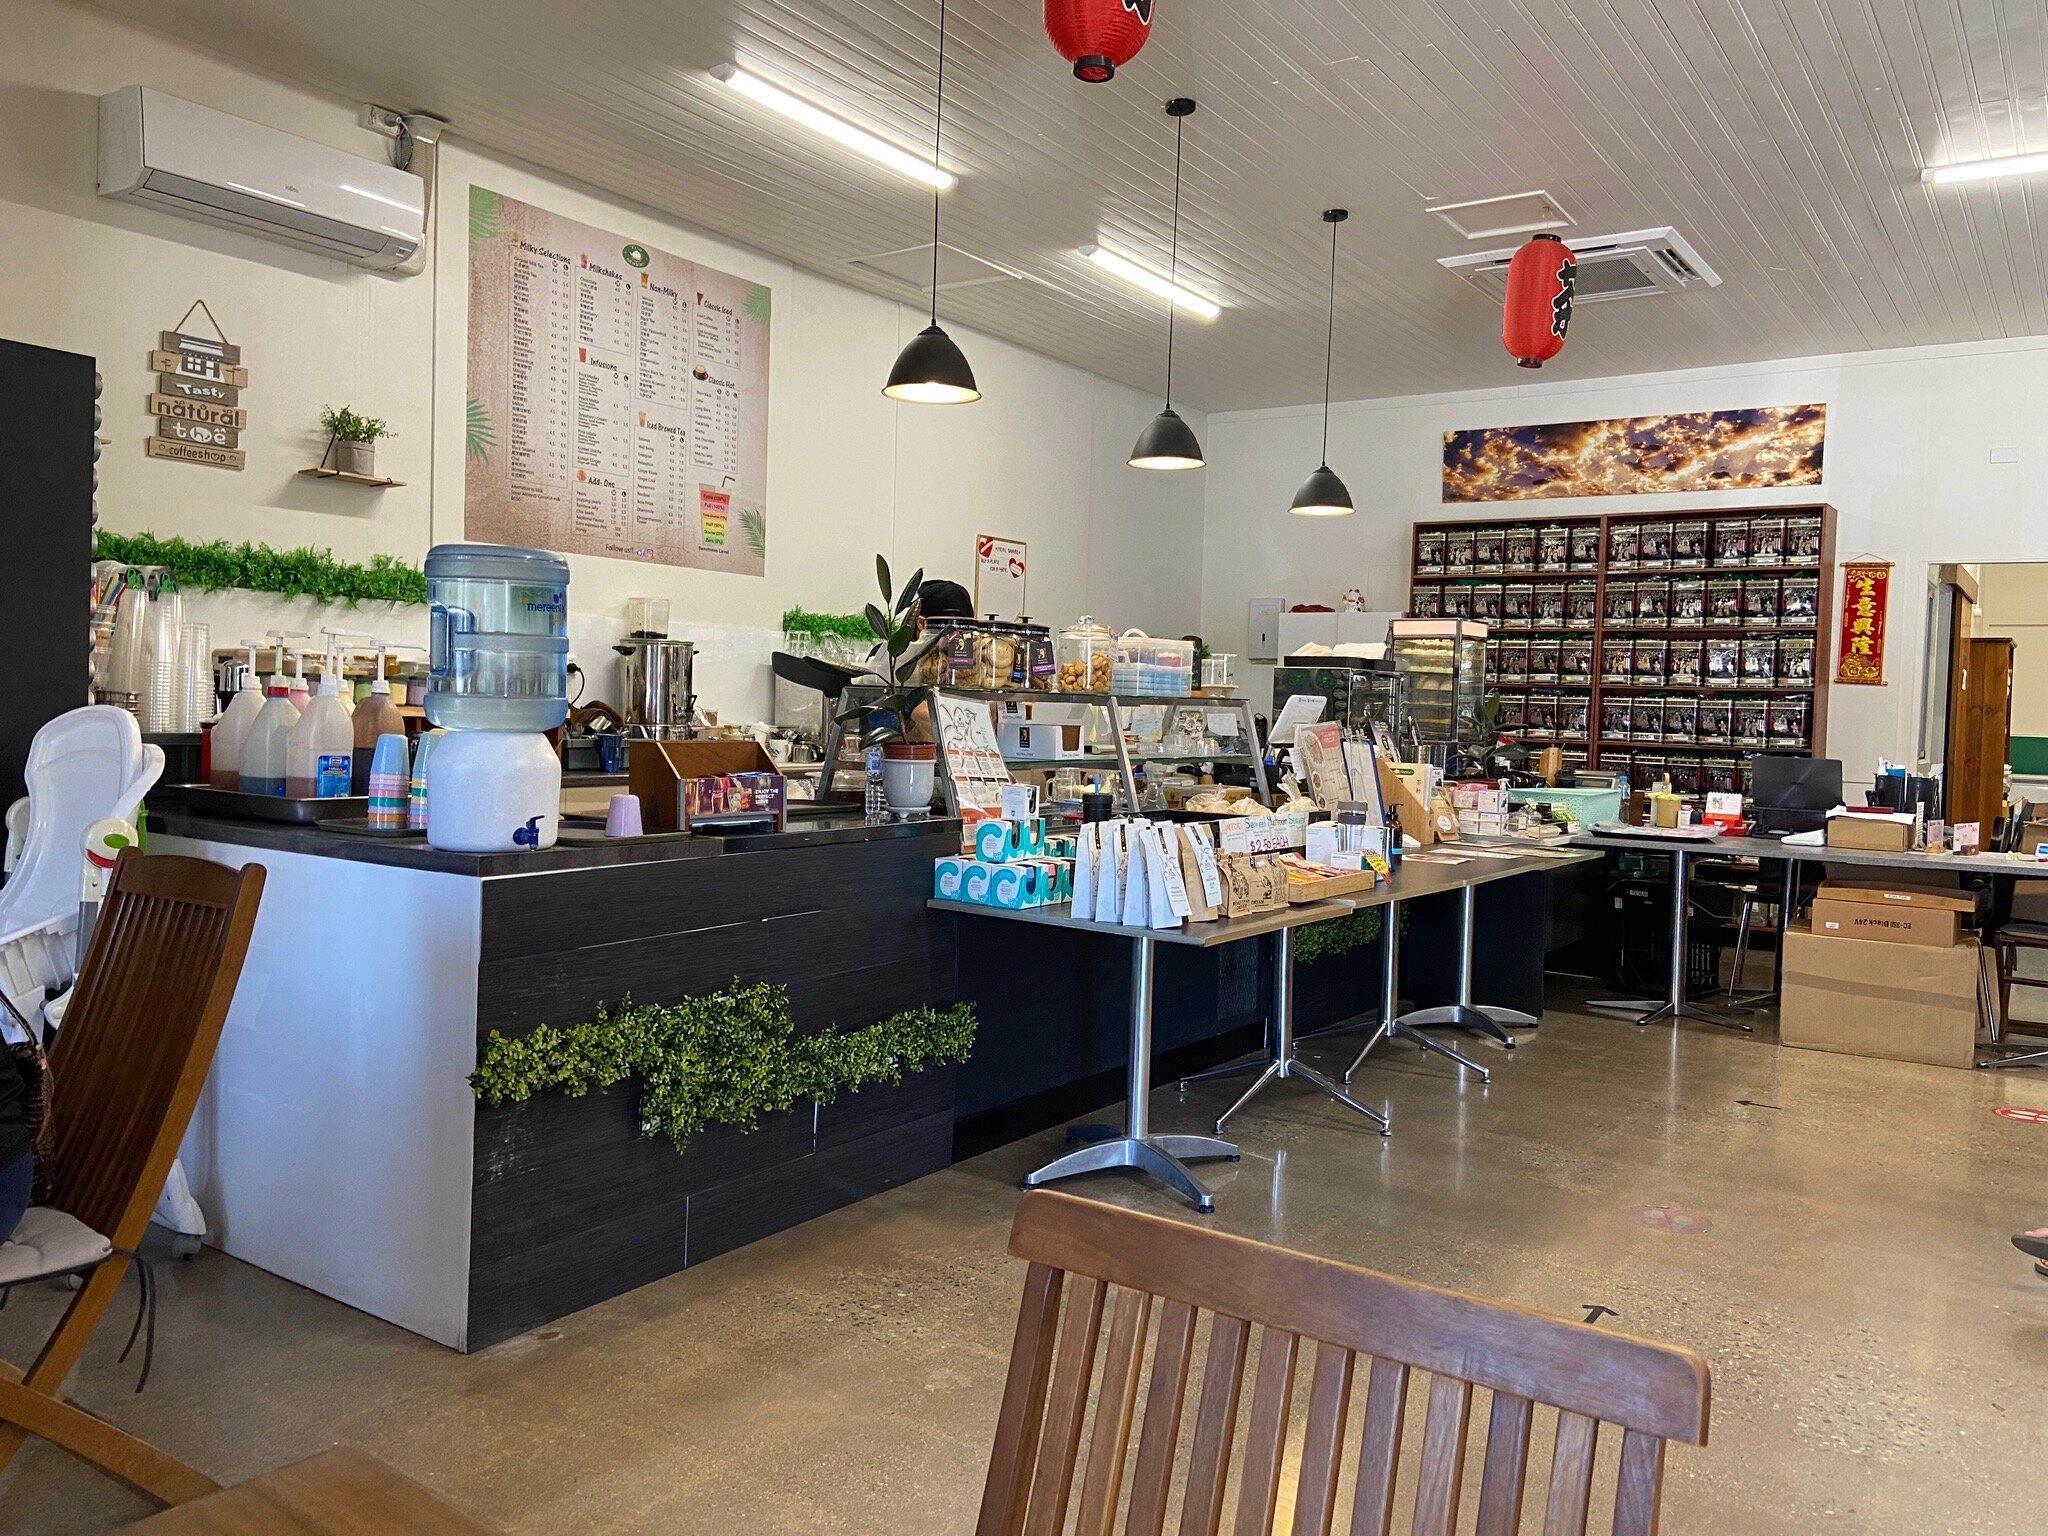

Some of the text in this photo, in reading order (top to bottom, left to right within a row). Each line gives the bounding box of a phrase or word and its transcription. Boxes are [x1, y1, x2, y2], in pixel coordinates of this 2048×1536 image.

[520, 241, 571, 264] Milky Selections
[590, 262, 623, 280] Milkshakes
[704, 299, 733, 316] Classic Iced
[590, 357, 618, 371] Infusions
[708, 376, 735, 389] Classic Hot
[176, 384, 228, 399] Tasty
[646, 420, 686, 437] Iced Brewed Tea
[605, 544, 623, 552] Follow
[1850, 577, 1877, 655] 生意興隆
[1272, 836, 1290, 849] EACH
[1854, 918, 1868, 926] 24V
[1868, 919, 1889, 928] Black
